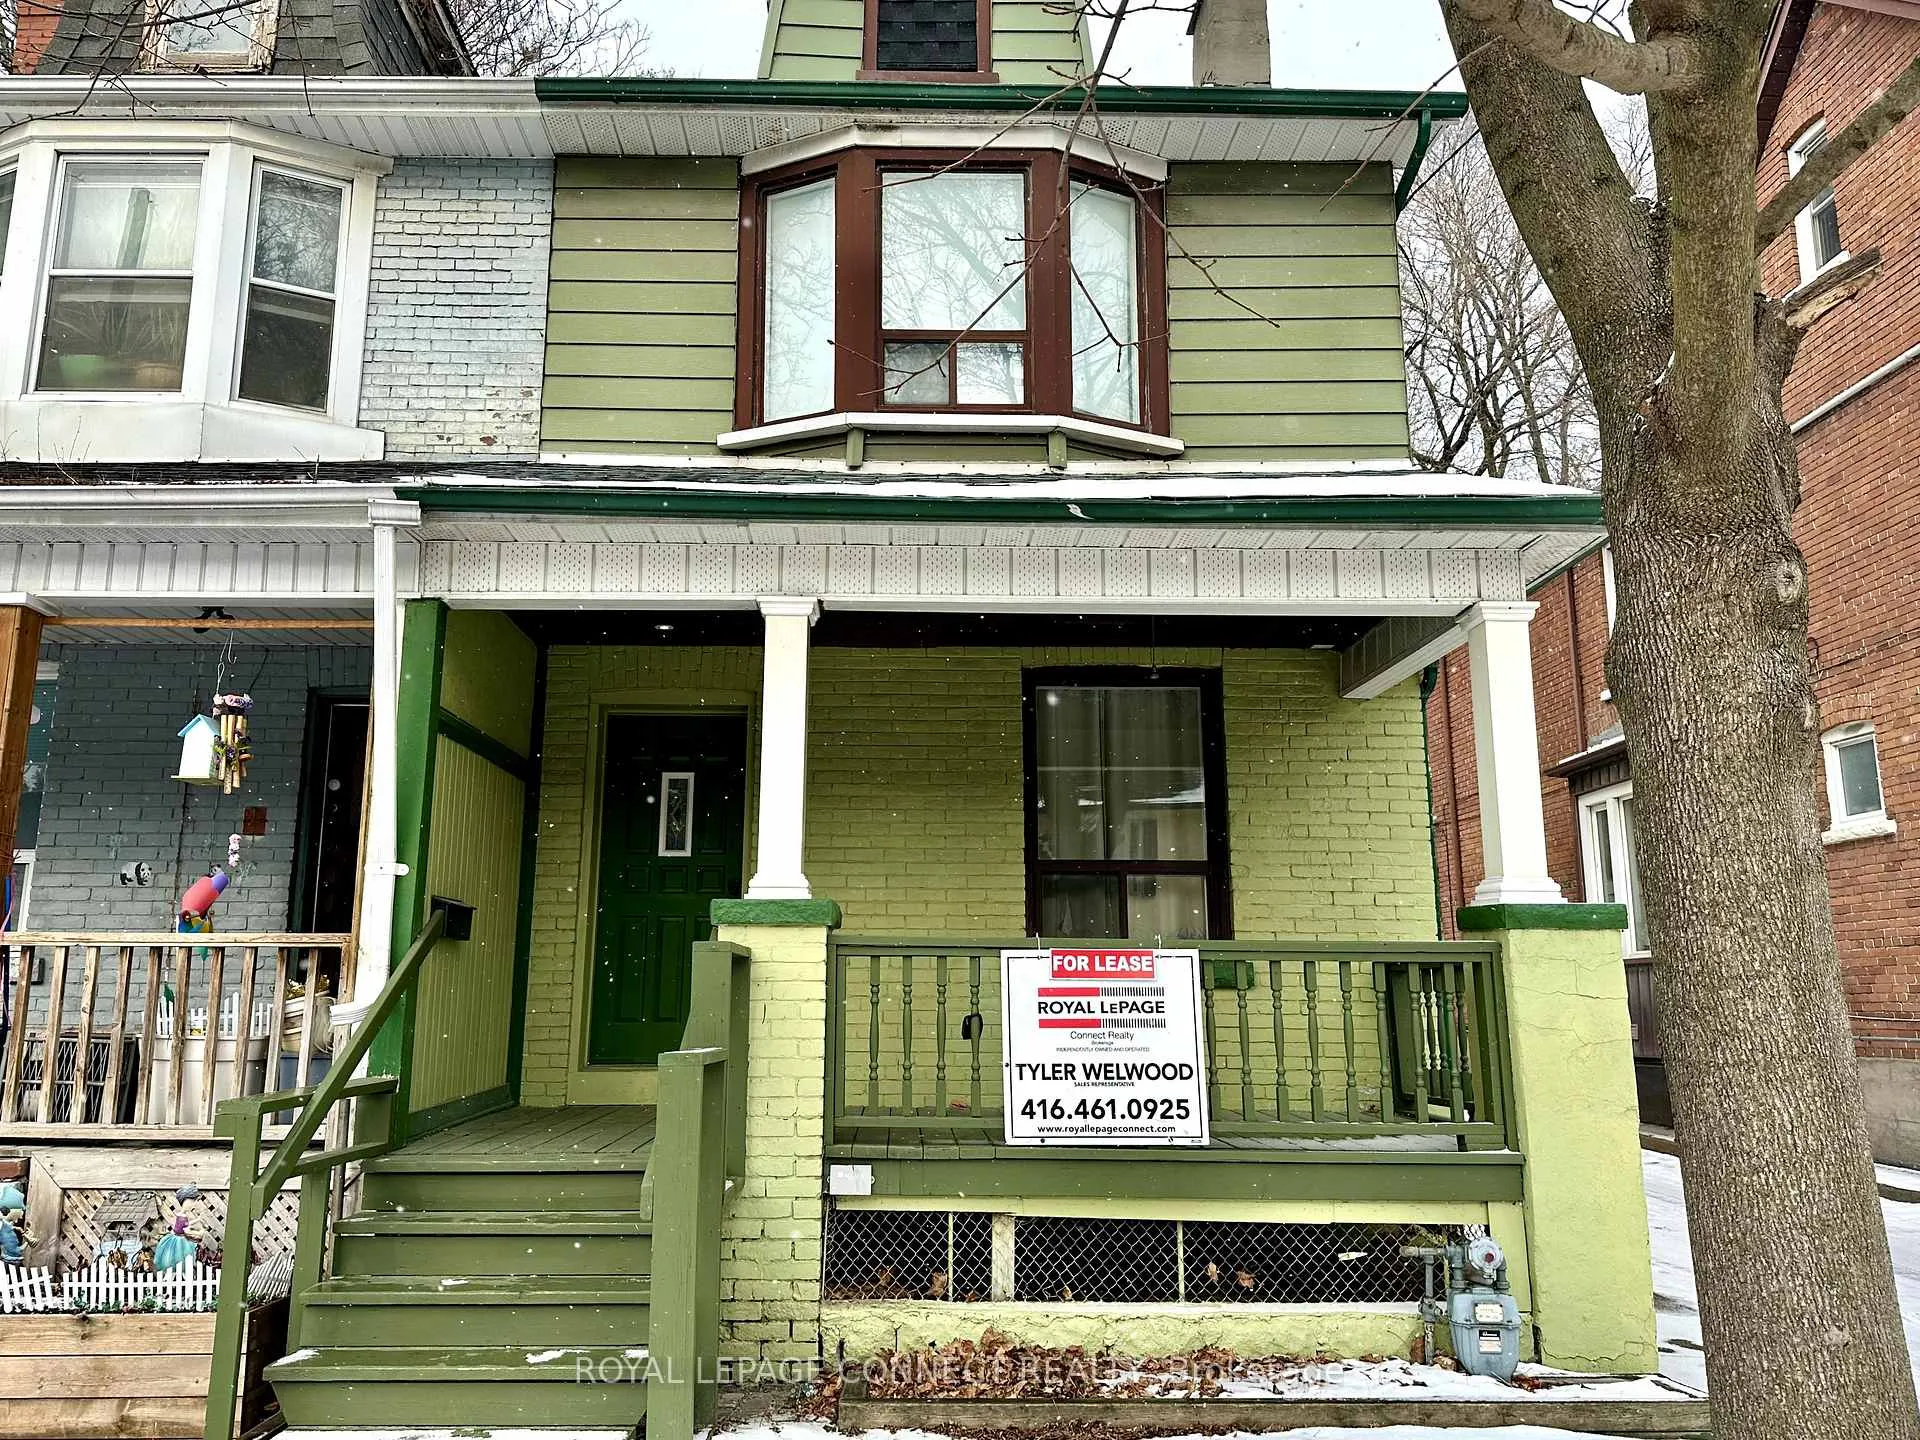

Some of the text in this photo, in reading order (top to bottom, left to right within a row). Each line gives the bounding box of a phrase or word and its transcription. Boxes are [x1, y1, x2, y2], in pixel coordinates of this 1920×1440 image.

[1052, 955, 1153, 972] FOR LEASE
[1038, 1001, 1095, 1014] ROYAL
[1070, 1031, 1134, 1041] Connect Realty
[1015, 1063, 1194, 1081] TYLER WELWOOD
[1020, 1098, 1190, 1120] 416.461.0925
[1037, 1124, 1176, 1135] www.royallepageconnect.com
